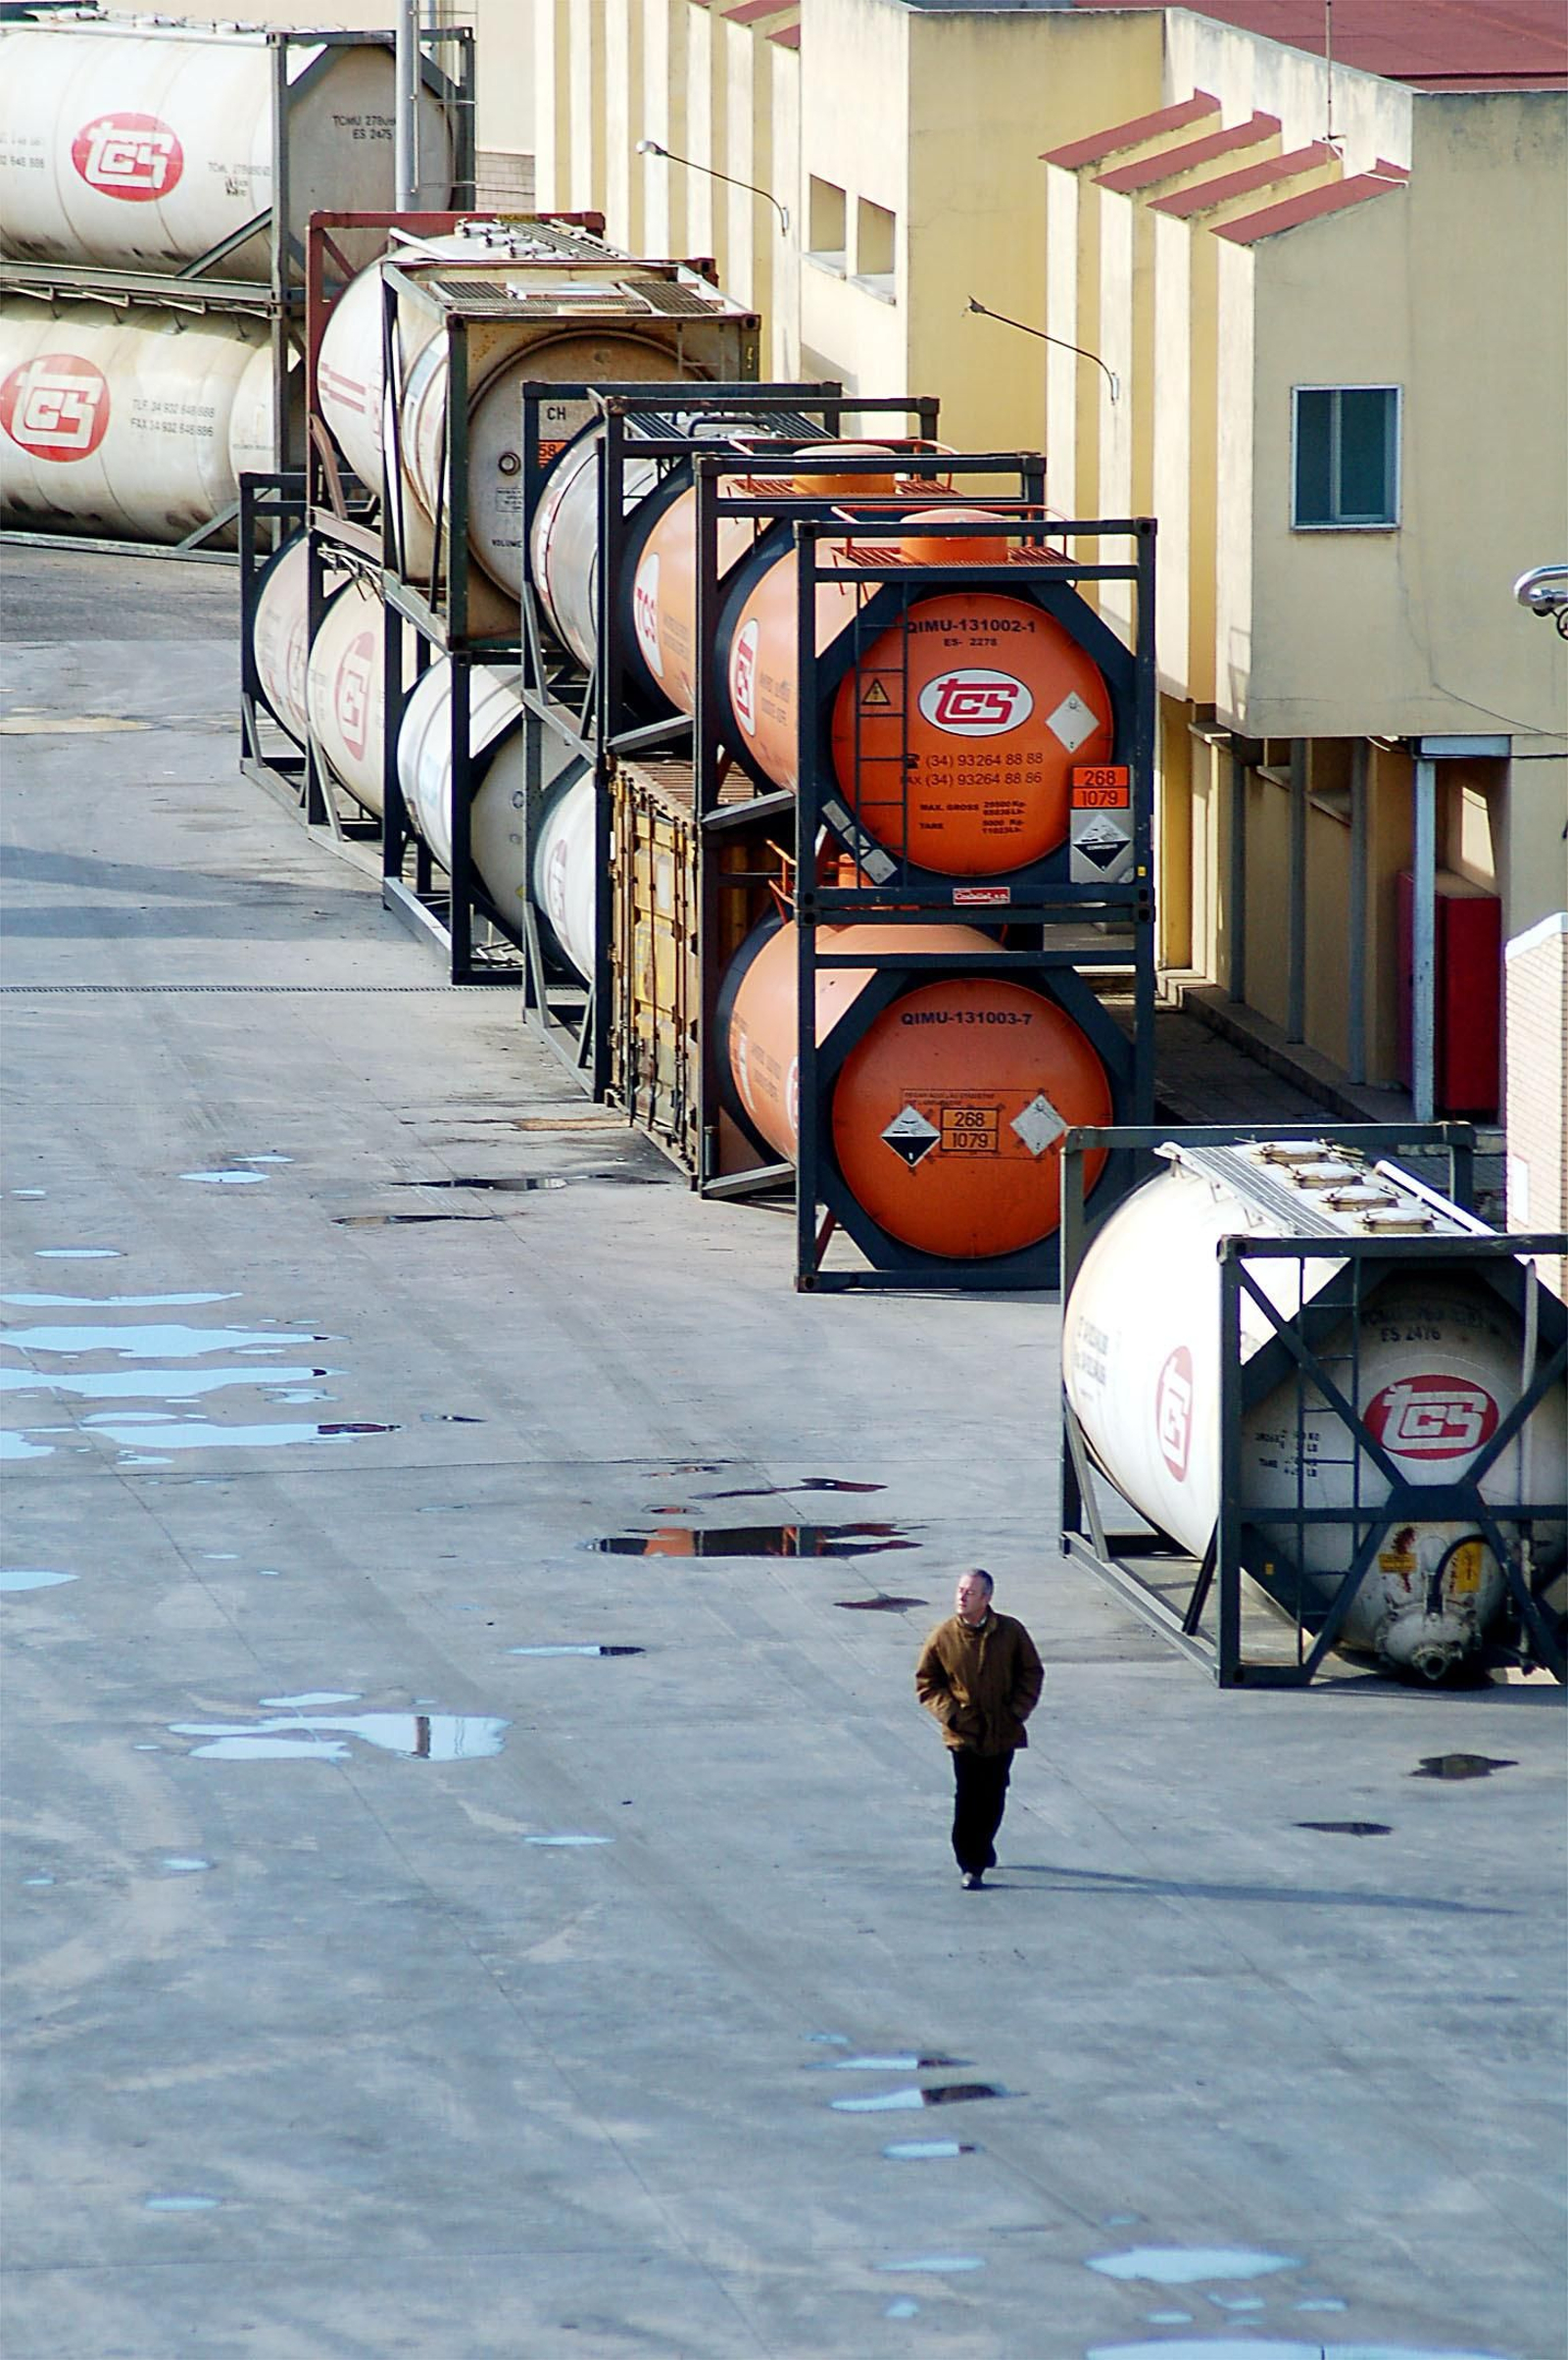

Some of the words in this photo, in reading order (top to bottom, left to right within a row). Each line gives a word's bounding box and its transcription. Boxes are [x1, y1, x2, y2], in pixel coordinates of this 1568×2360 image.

[353, 127, 367, 139] ES
[546, 406, 566, 420] CH
[925, 754, 954, 769] (34)
[1005, 753, 1023, 765] 88
[1026, 752, 1044, 764] 88
[925, 773, 954, 788] (34)
[1004, 771, 1022, 785] 88
[1084, 769, 1116, 786] 268
[1082, 790, 1117, 806] 1079
[902, 1011, 1033, 1025] QIMU-131003-7
[954, 1112, 985, 1127] 268
[953, 1133, 989, 1148] 1079
